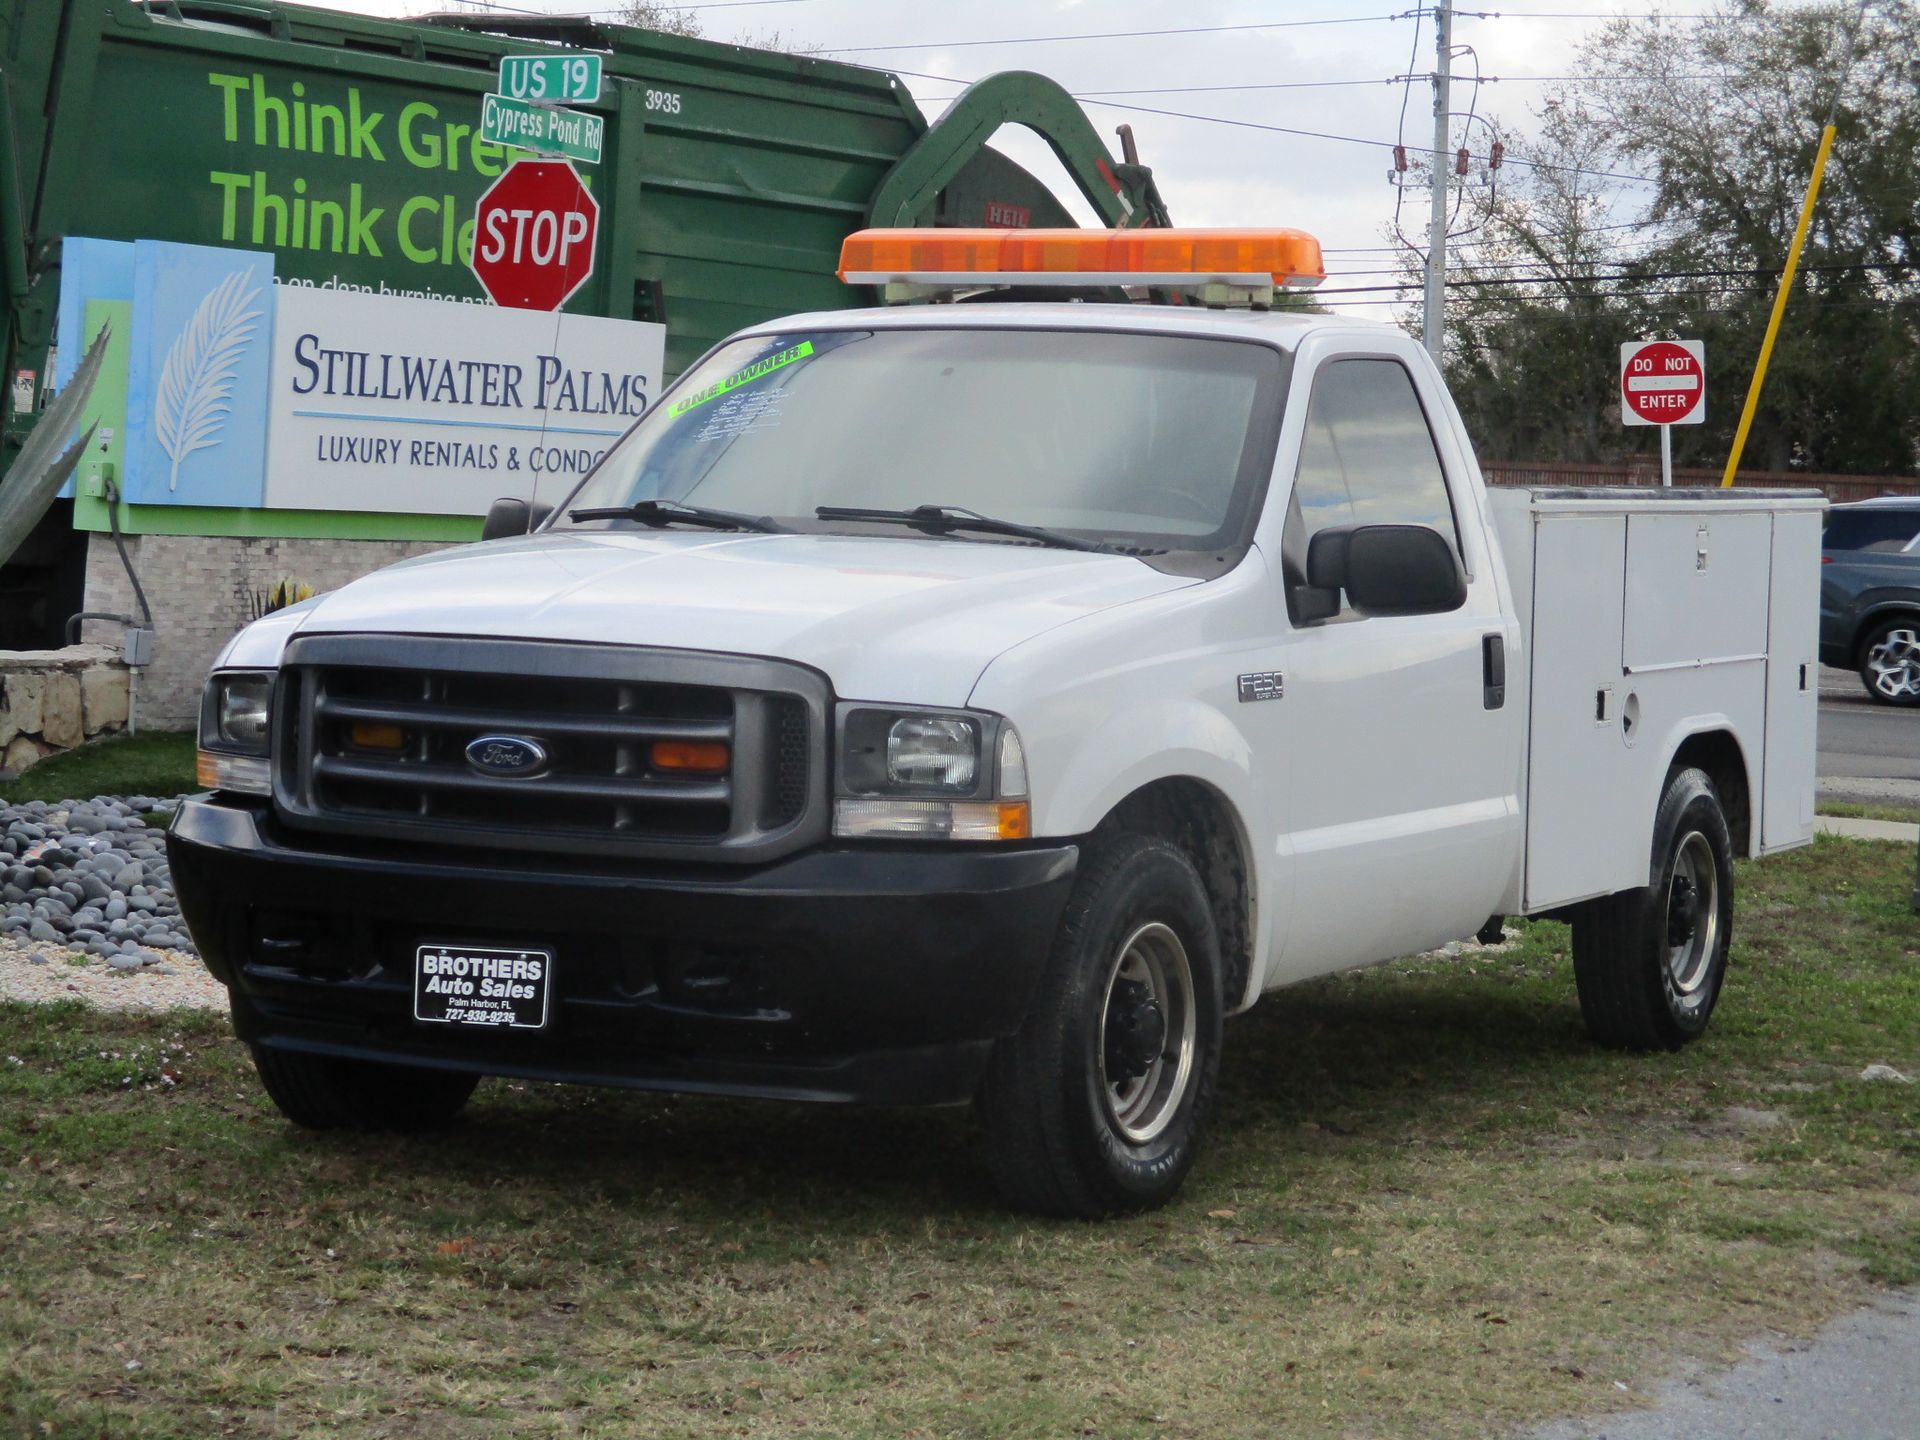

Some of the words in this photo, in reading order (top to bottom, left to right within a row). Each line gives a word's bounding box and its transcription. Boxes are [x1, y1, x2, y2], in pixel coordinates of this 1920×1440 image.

[511, 60, 547, 98] US
[562, 59, 588, 97] 19
[646, 89, 681, 114] 3935
[209, 72, 386, 162] Think
[398, 101, 591, 189] Gre
[485, 98, 543, 139] Cypress
[548, 111, 581, 146] Pond
[585, 119, 600, 151] Rd
[210, 170, 385, 258] Think
[990, 206, 1027, 228] HEIL
[481, 207, 588, 266] STOP
[292, 333, 524, 409] STILLWATER
[533, 354, 648, 418] PALMS
[1634, 358, 1653, 372] DO
[1665, 357, 1692, 371] NOT
[675, 382, 721, 412] ONE
[724, 345, 803, 389] OWNER
[1640, 394, 1687, 409] ENTER
[317, 434, 402, 465] LUXURY
[410, 440, 498, 470] RENTALS
[506, 446, 521, 471] &
[483, 743, 524, 766] Ford
[422, 954, 542, 981] BROTHERS
[425, 975, 474, 996] Auto
[479, 977, 536, 1000] Sales
[444, 1008, 516, 1024] 727-938-9235
[448, 997, 469, 1008] Palm
[470, 999, 500, 1010] Harbor,
[501, 1002, 512, 1010] FL
